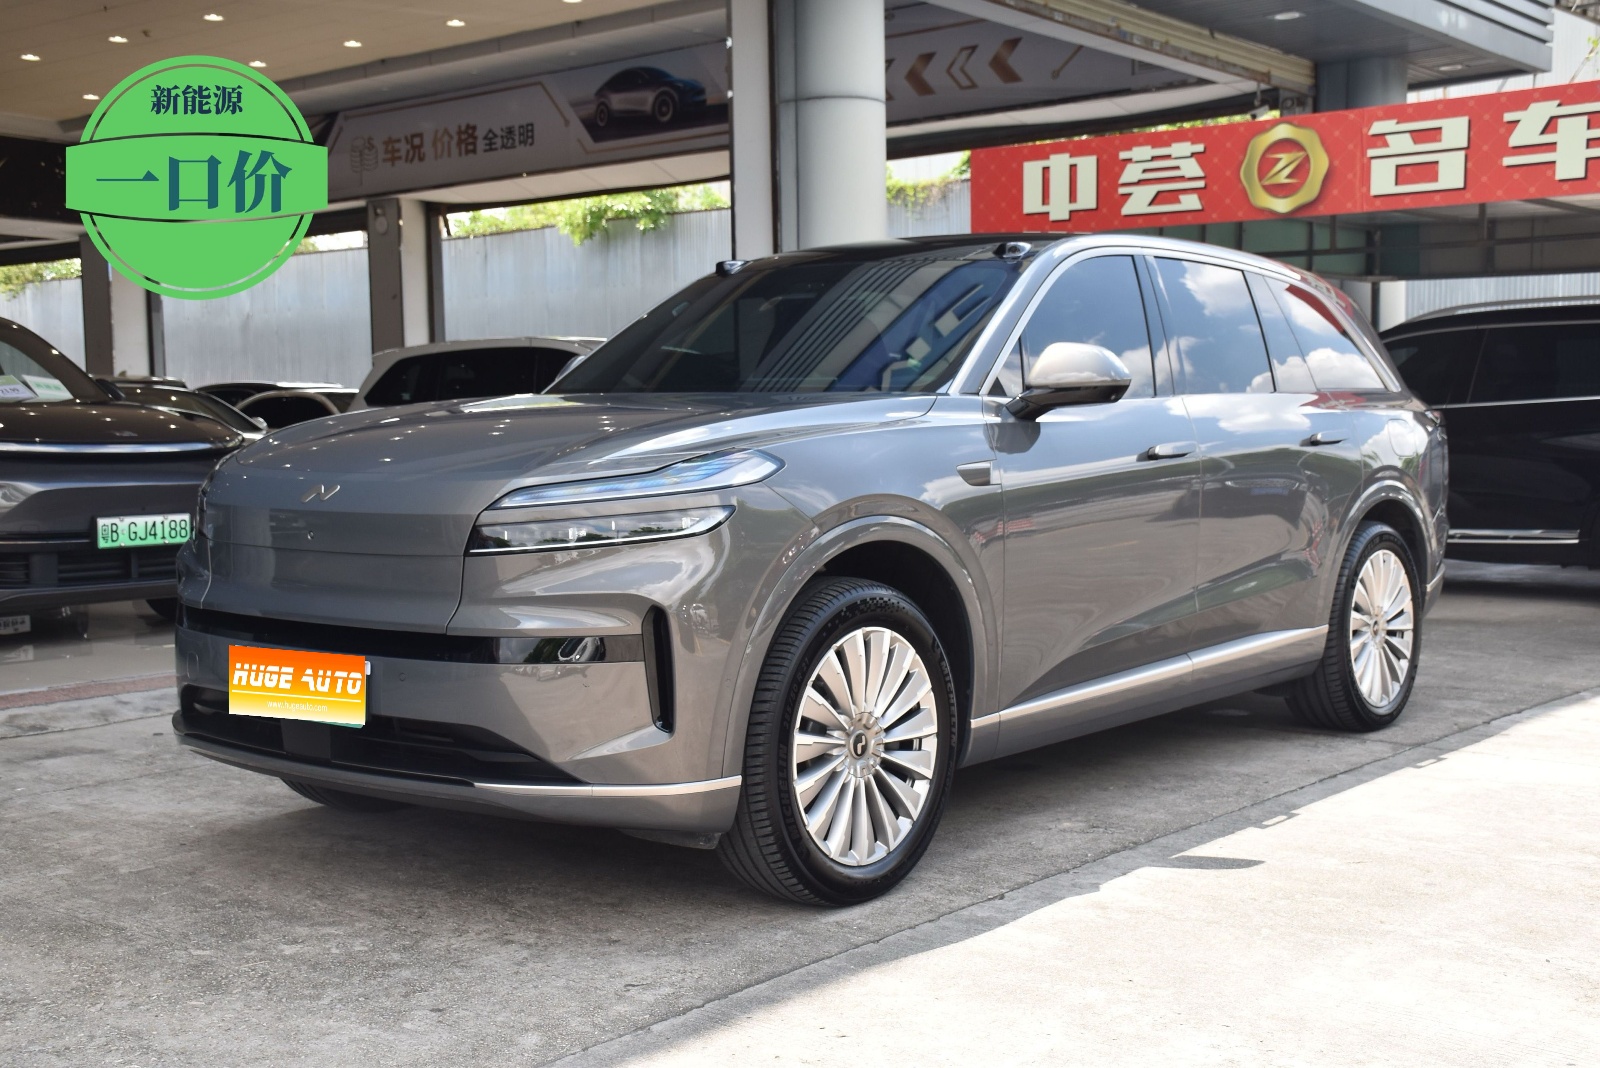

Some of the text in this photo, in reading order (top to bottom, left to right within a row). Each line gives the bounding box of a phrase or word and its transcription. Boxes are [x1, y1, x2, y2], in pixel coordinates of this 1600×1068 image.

[382, 122, 535, 167] 车况 价格 全透明
[1022, 141, 1206, 222] 中荟
[1366, 100, 1600, 197] 名车
[128, 519, 188, 542] GJ4188
[940, 660, 957, 748] MICHELIN
[779, 743, 802, 842] MICHELIN
